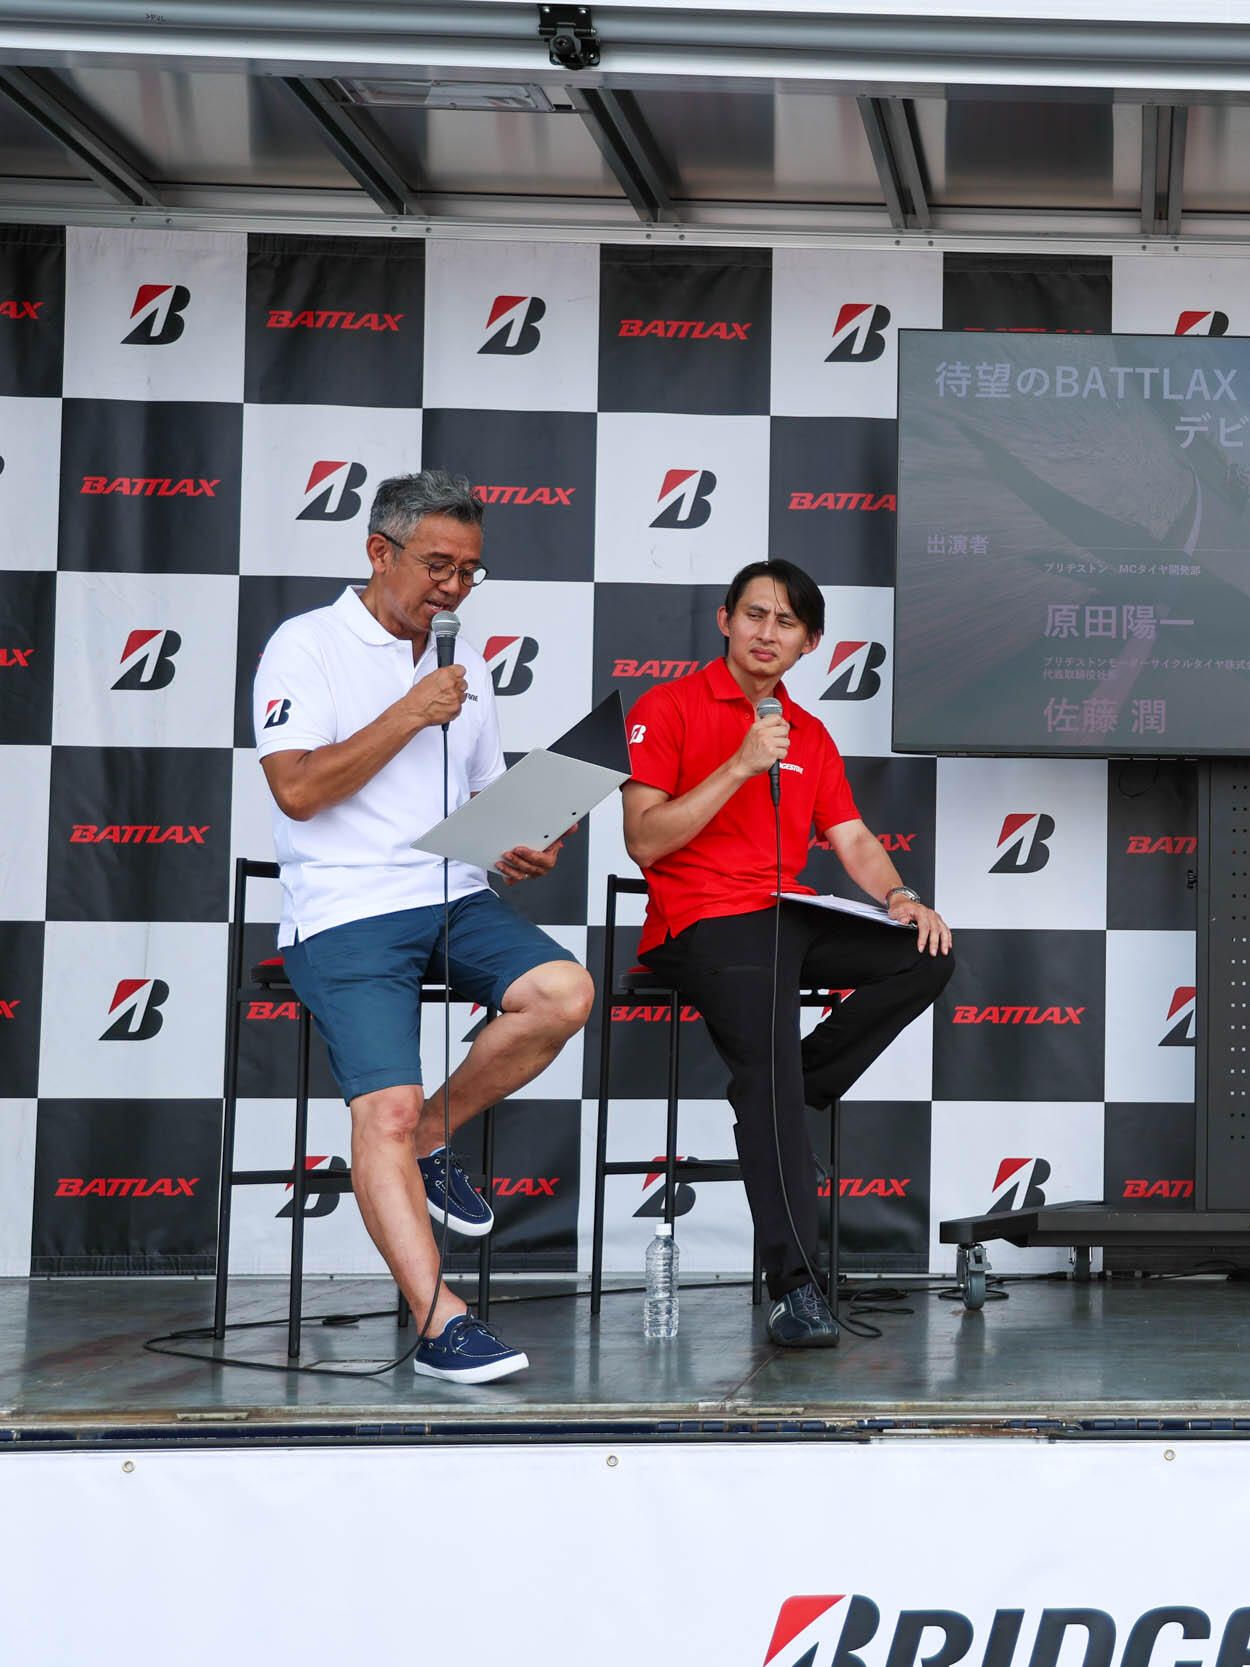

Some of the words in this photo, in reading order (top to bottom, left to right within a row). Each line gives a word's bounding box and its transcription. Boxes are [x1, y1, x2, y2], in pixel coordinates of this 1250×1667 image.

[266, 310, 404, 332] BATTLAX
[618, 319, 752, 341] BATTLAX
[80, 475, 220, 497] BATTLAX
[473, 485, 576, 505] ATTLAX
[789, 492, 896, 512] BATTLA
[927, 534, 990, 556] 出演者
[1043, 603, 1195, 641] 原田陽一
[1043, 698, 1117, 734] 佐藤
[1131, 699, 1167, 734] 潤
[69, 824, 209, 844] BATTLAX
[1128, 835, 1198, 855] BATT
[952, 1005, 1086, 1025] BATTLAX
[56, 1177, 200, 1198] BATTLAX
[1123, 1179, 1194, 1199] BATT
